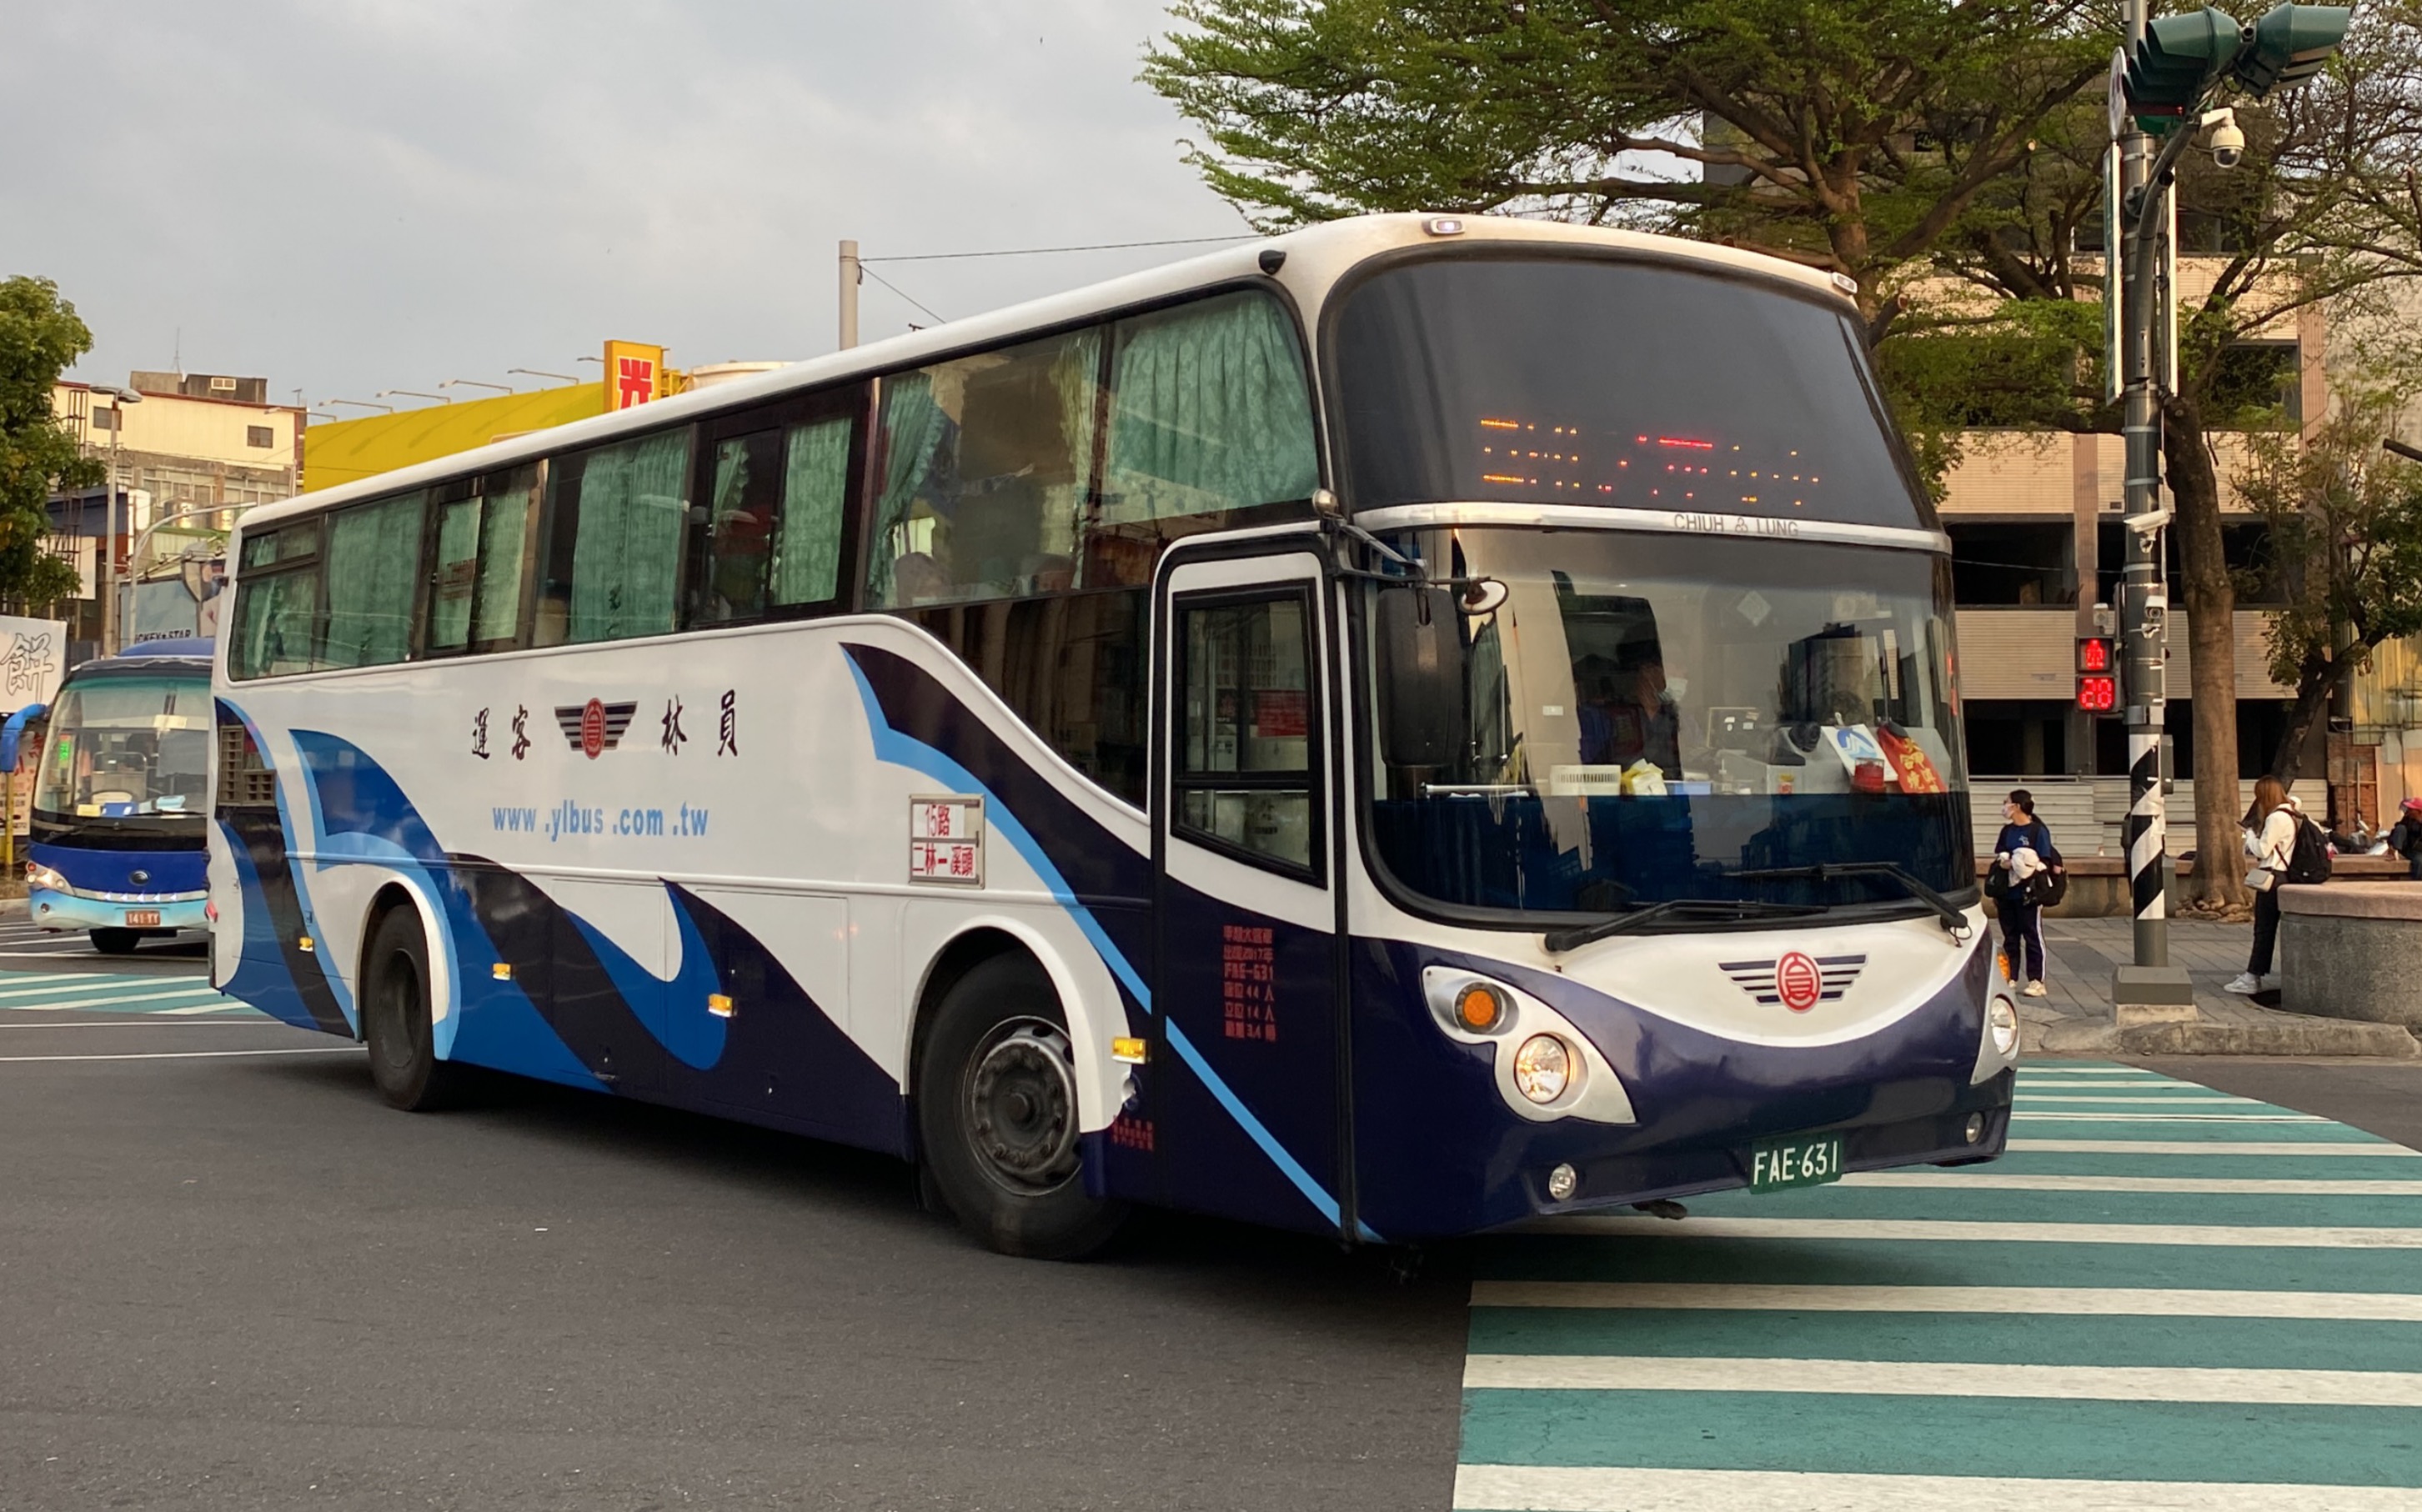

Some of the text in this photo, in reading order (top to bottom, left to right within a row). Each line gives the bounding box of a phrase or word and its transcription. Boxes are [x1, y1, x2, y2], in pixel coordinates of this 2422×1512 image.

[1674, 513, 1799, 536] CHIUH LUNG
[2081, 678, 2113, 708] 20
[925, 804, 950, 837] 15路
